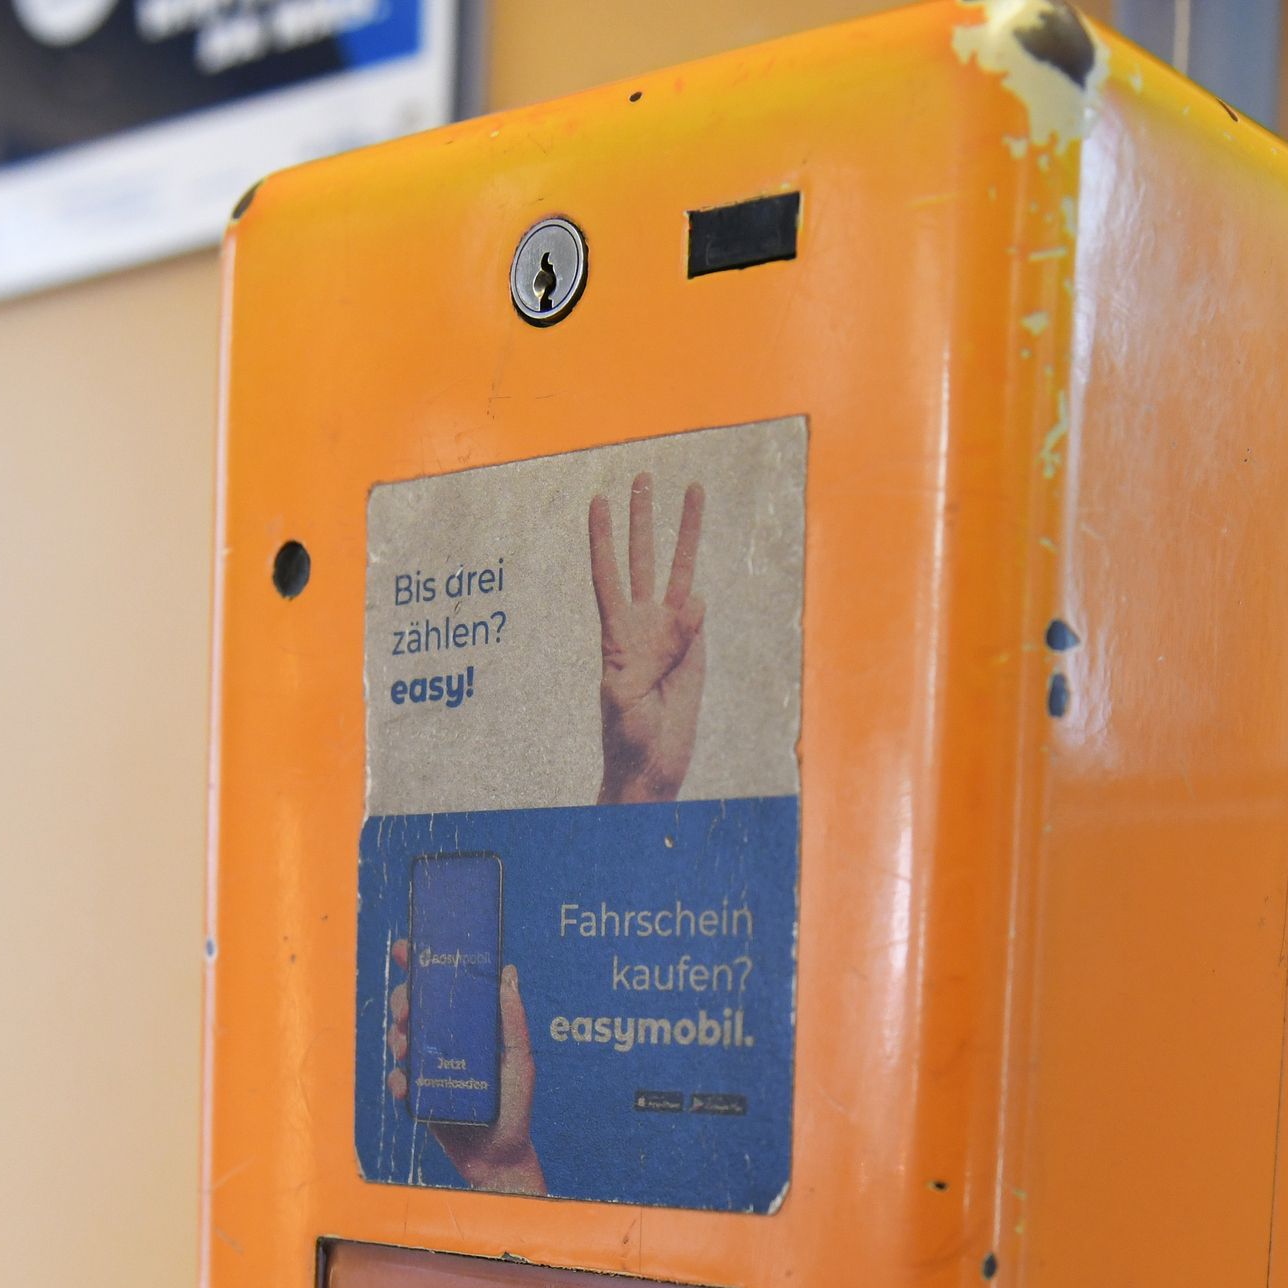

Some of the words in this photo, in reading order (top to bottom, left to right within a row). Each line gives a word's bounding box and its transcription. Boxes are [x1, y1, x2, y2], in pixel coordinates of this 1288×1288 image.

[394, 570, 436, 606] Bis
[444, 558, 505, 599] drei
[392, 611, 507, 656] zählen?
[390, 666, 475, 708] easy!
[559, 901, 754, 938] Fahrschein
[612, 957, 754, 992] kaufen?
[550, 1008, 755, 1052] easymobil.
